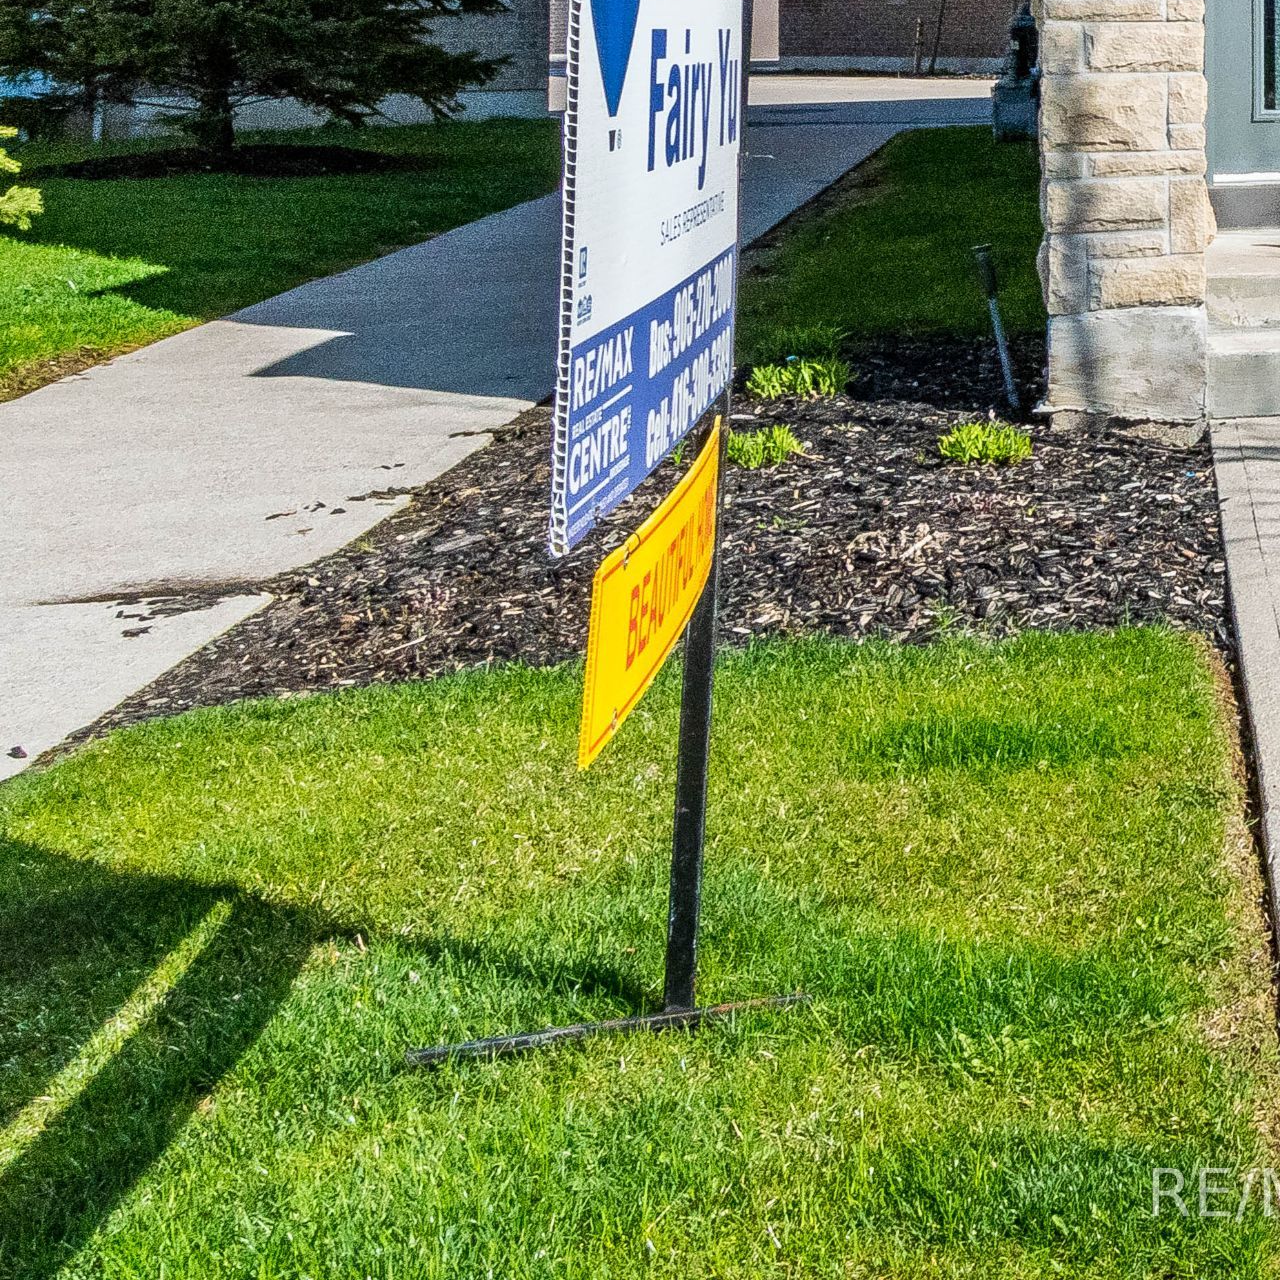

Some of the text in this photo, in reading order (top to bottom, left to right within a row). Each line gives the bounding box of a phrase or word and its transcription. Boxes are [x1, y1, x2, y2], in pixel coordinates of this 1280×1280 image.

[647, 28, 738, 191] Fairy Yu
[573, 325, 634, 412] RE/MAX
[649, 319, 672, 379] Bus:
[568, 408, 629, 495] CENTRE
[626, 511, 694, 672] BEAUTIFUL
